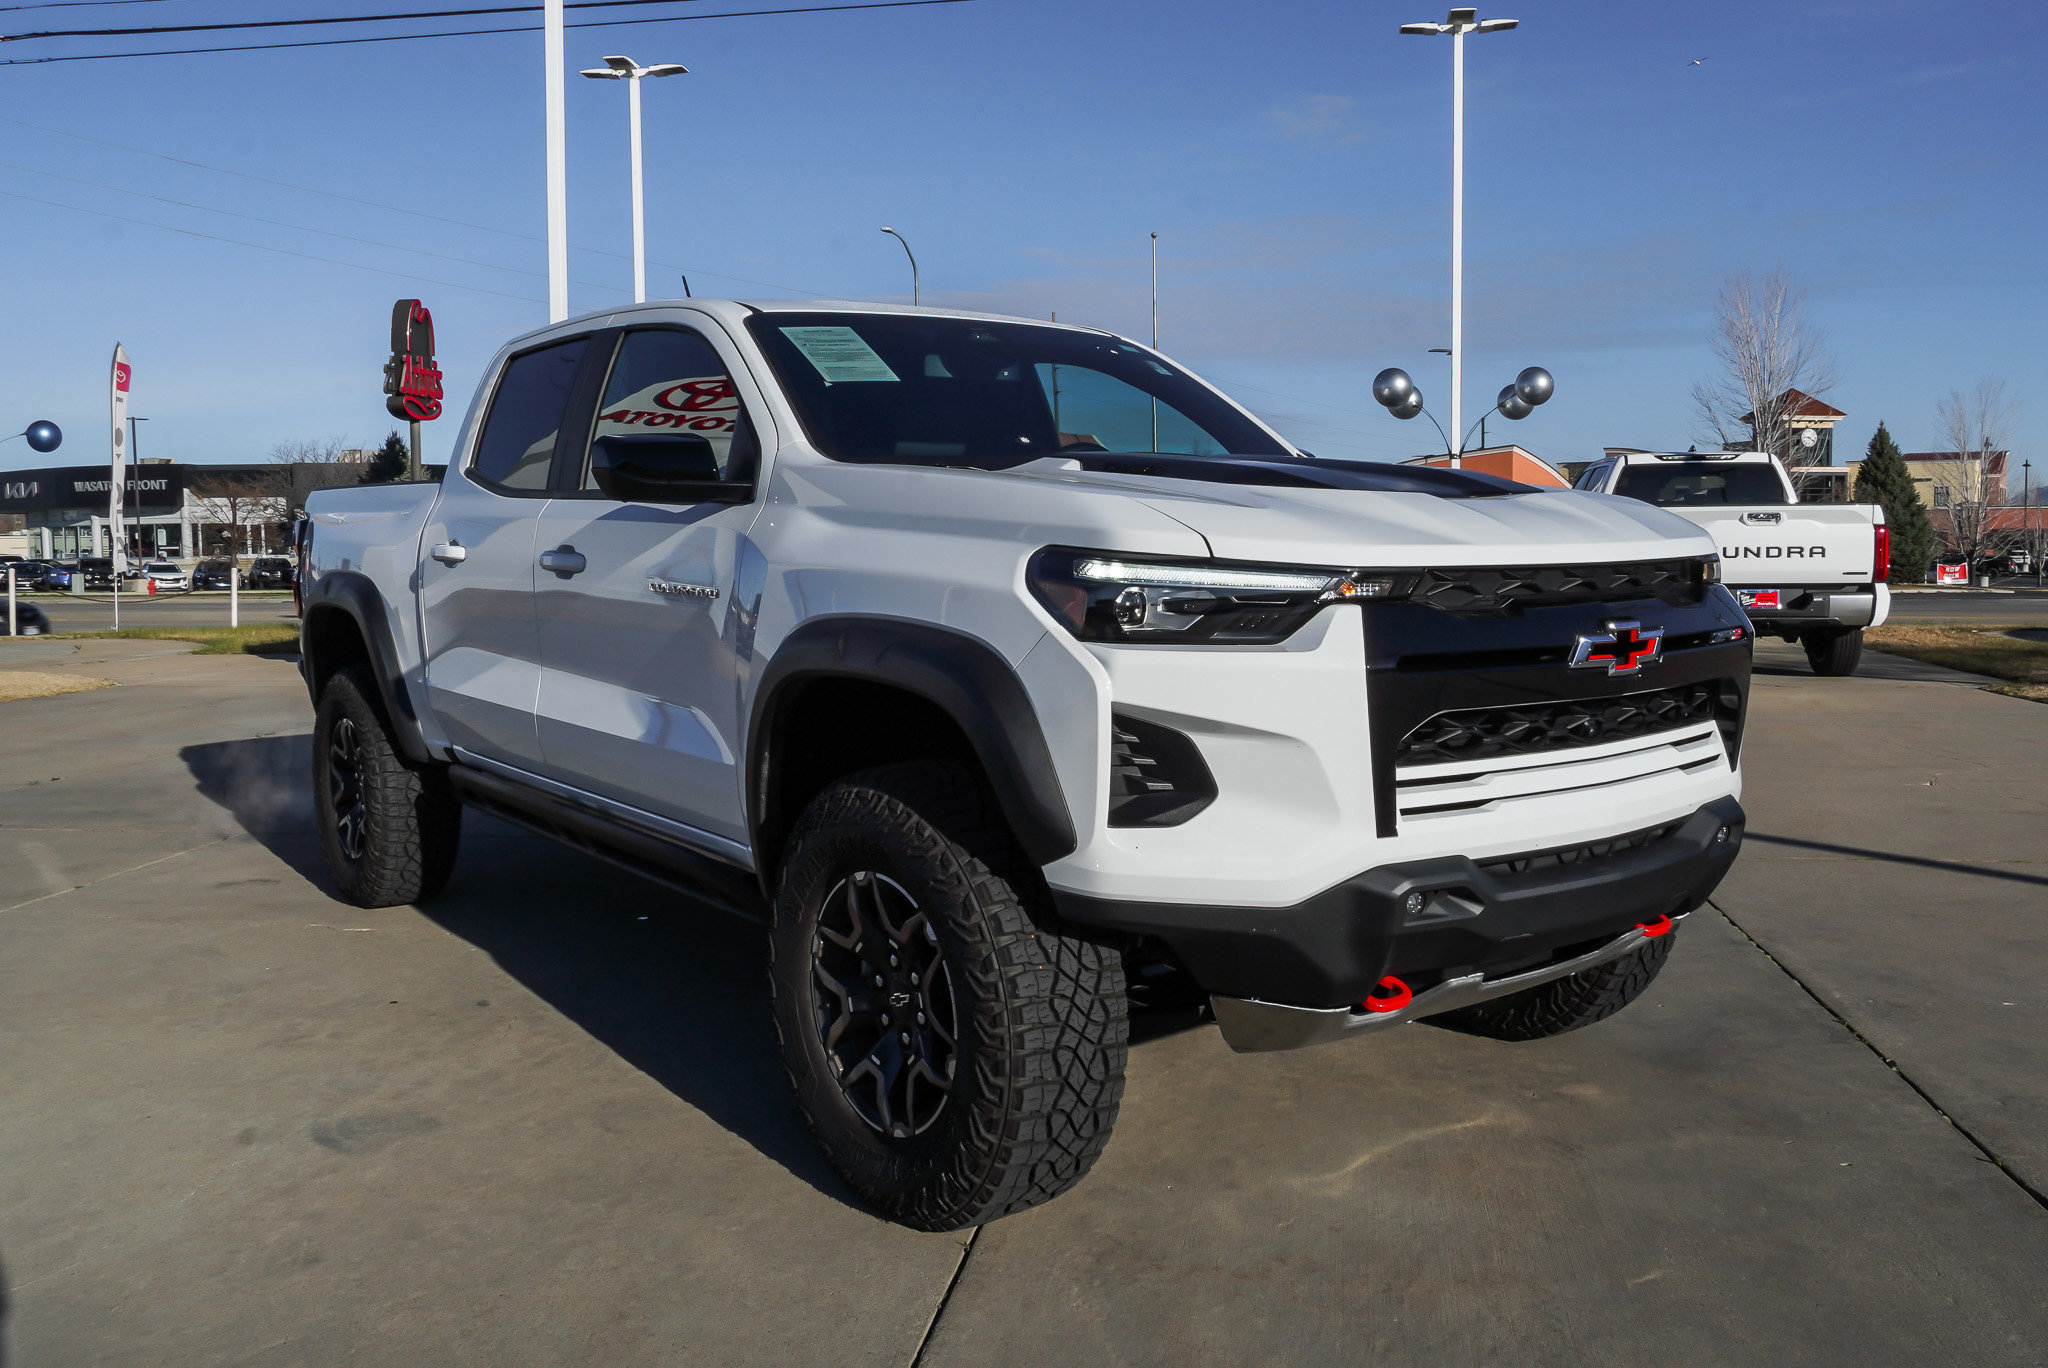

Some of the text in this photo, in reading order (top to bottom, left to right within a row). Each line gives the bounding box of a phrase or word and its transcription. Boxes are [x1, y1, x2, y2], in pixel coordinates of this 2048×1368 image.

[5, 482, 38, 499] KIA
[74, 479, 168, 493] WASAT FRONT
[1722, 546, 1826, 559] UNDRA
